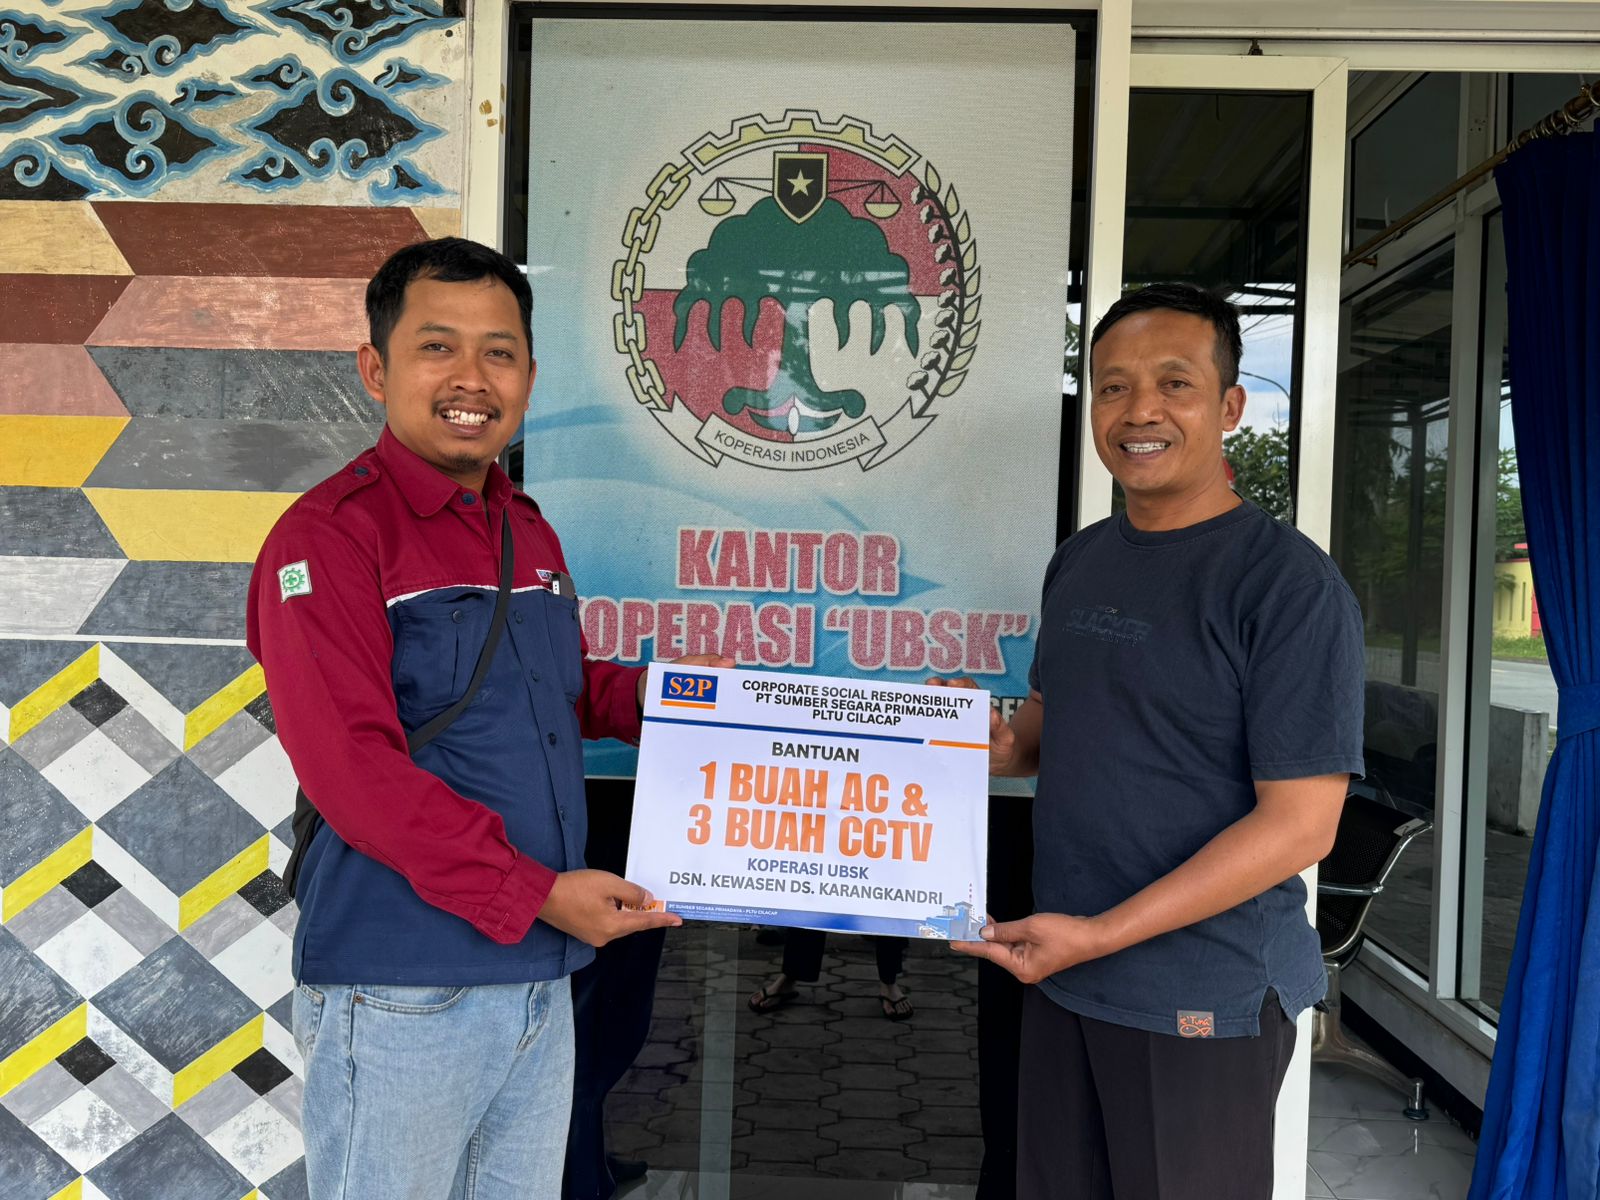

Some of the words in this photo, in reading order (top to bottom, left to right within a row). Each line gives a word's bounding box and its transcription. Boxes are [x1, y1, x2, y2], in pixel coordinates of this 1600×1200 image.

[714, 429, 787, 463] KOPERASI
[790, 432, 870, 463] INDONESIA
[677, 527, 899, 594] KANTOR
[578, 597, 815, 665] OPERASI
[668, 676, 713, 697] S2P
[742, 679, 819, 696] CORPORATE
[821, 686, 868, 701] SOCIAL
[871, 690, 974, 709] RESPONSIBILITY
[755, 692, 773, 704] PT
[774, 694, 829, 709] SUMBER
[831, 699, 882, 713] SEGARA
[884, 703, 959, 720] PRIMADAYA
[812, 709, 844, 722] PLTU
[846, 711, 901, 726] CILACAP
[771, 741, 860, 763] BANTUAN
[698, 760, 717, 800] 1
[728, 762, 829, 809] BUAH
[839, 772, 890, 814] AC
[901, 782, 929, 817] &
[686, 803, 712, 846] 3
[724, 806, 826, 854] BUAH
[838, 815, 934, 862] CCTV
[747, 857, 823, 877] KOPERASI
[827, 864, 869, 880] UBSK
[668, 871, 706, 887] DSN.
[710, 873, 786, 893] KEWASEN
[789, 880, 816, 895] DS.
[819, 882, 943, 905] KARANGKANDRI
